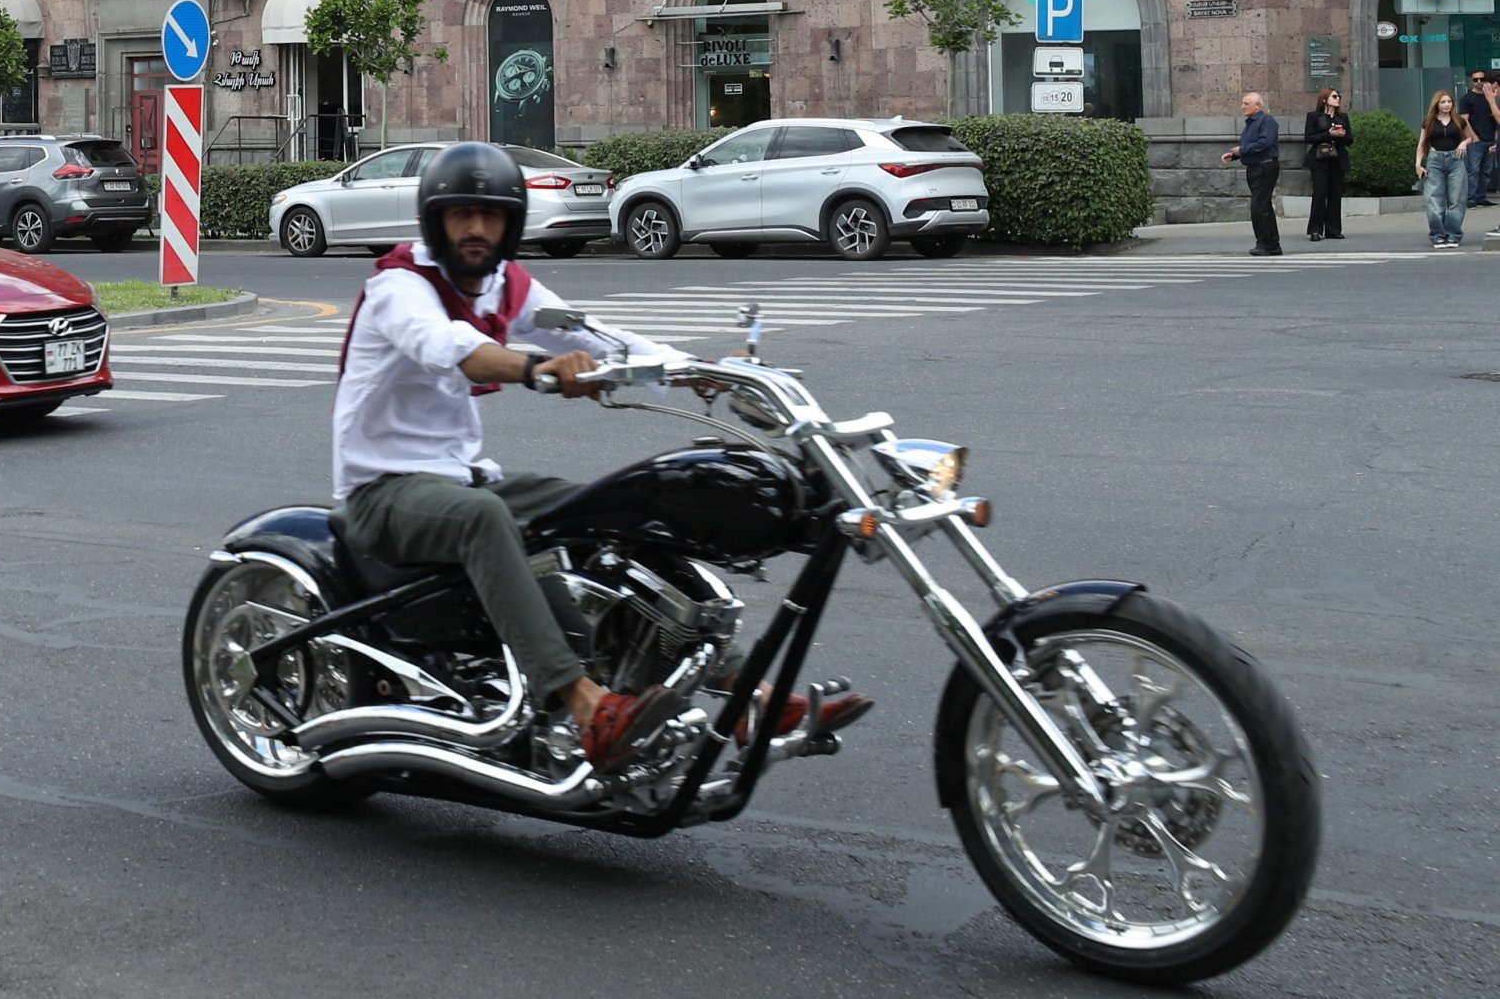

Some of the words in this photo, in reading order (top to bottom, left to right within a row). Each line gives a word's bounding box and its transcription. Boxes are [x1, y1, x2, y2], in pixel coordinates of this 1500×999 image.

[703, 40, 747, 53] RIVOLI
[701, 53, 751, 66] deLUXE
[1050, 94, 1059, 102] 15
[1060, 91, 1073, 102] 20
